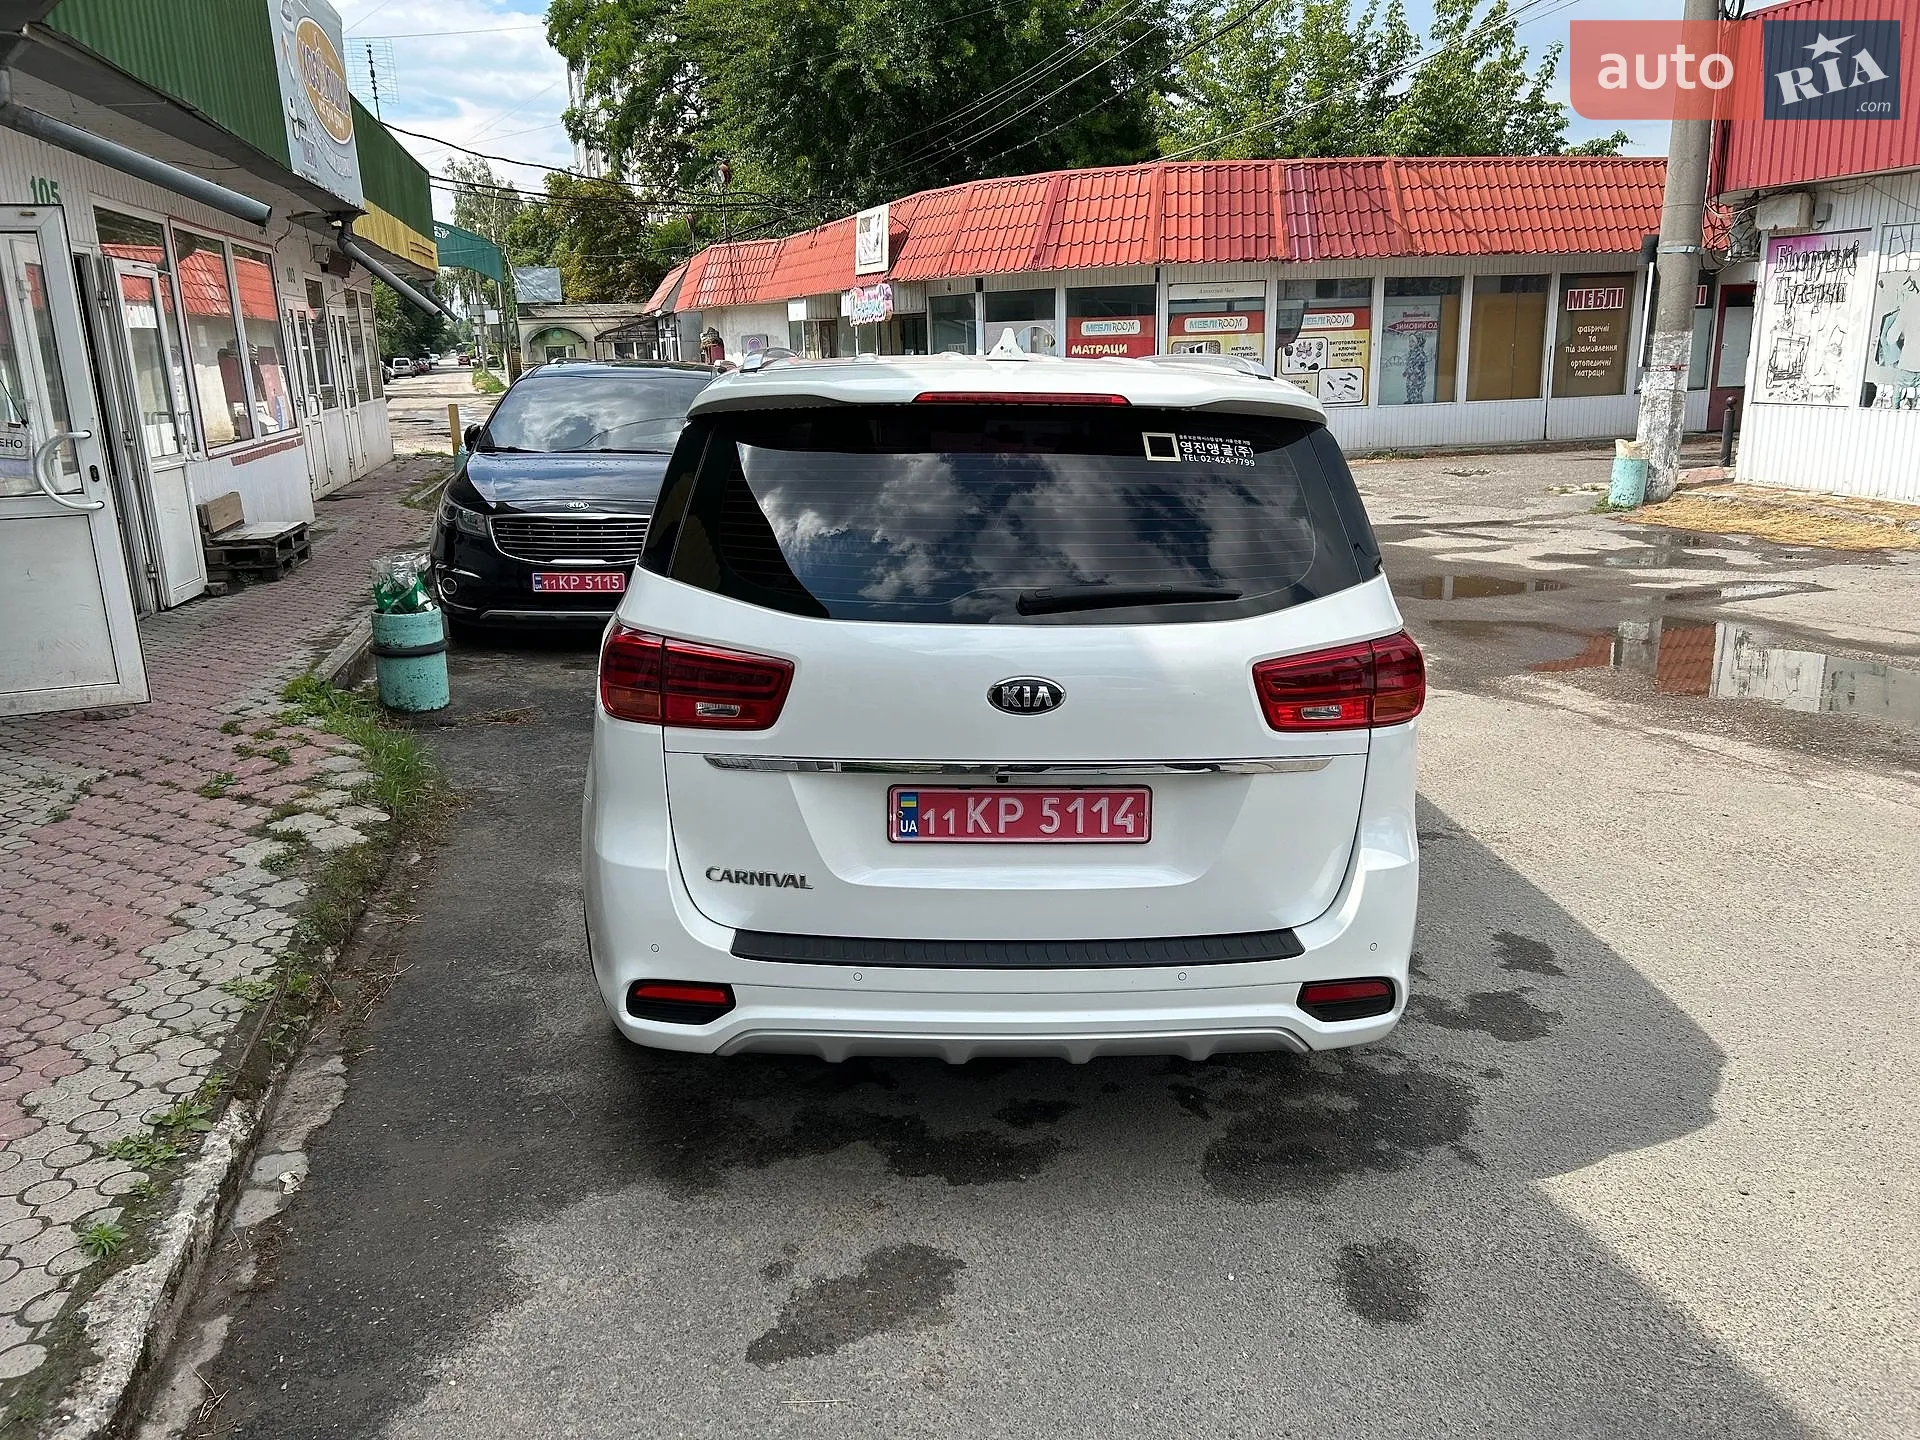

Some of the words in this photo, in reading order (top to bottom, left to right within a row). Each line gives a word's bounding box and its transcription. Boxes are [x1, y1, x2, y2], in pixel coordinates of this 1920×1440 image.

[30, 175, 60, 203] 105
[1567, 288, 1624, 311] МЕБЛІ
[1577, 323, 1610, 336] фабричні
[1071, 343, 1128, 356] МАТРАЦИ
[1565, 345, 1576, 353] під
[1577, 344, 1618, 353] замовлення
[1570, 357, 1612, 369] ортопедичні
[1575, 369, 1606, 379] матраци
[1180, 441, 1254, 457] 영진앵글(주)
[1183, 453, 1199, 462] TEL
[1201, 455, 1255, 466] 02-424-7799
[585, 576, 620, 590] 5115
[1001, 685, 1053, 708] KIA
[900, 820, 918, 833] UA
[1040, 797, 1136, 835] 5114
[705, 865, 814, 890] CARNIVAL
